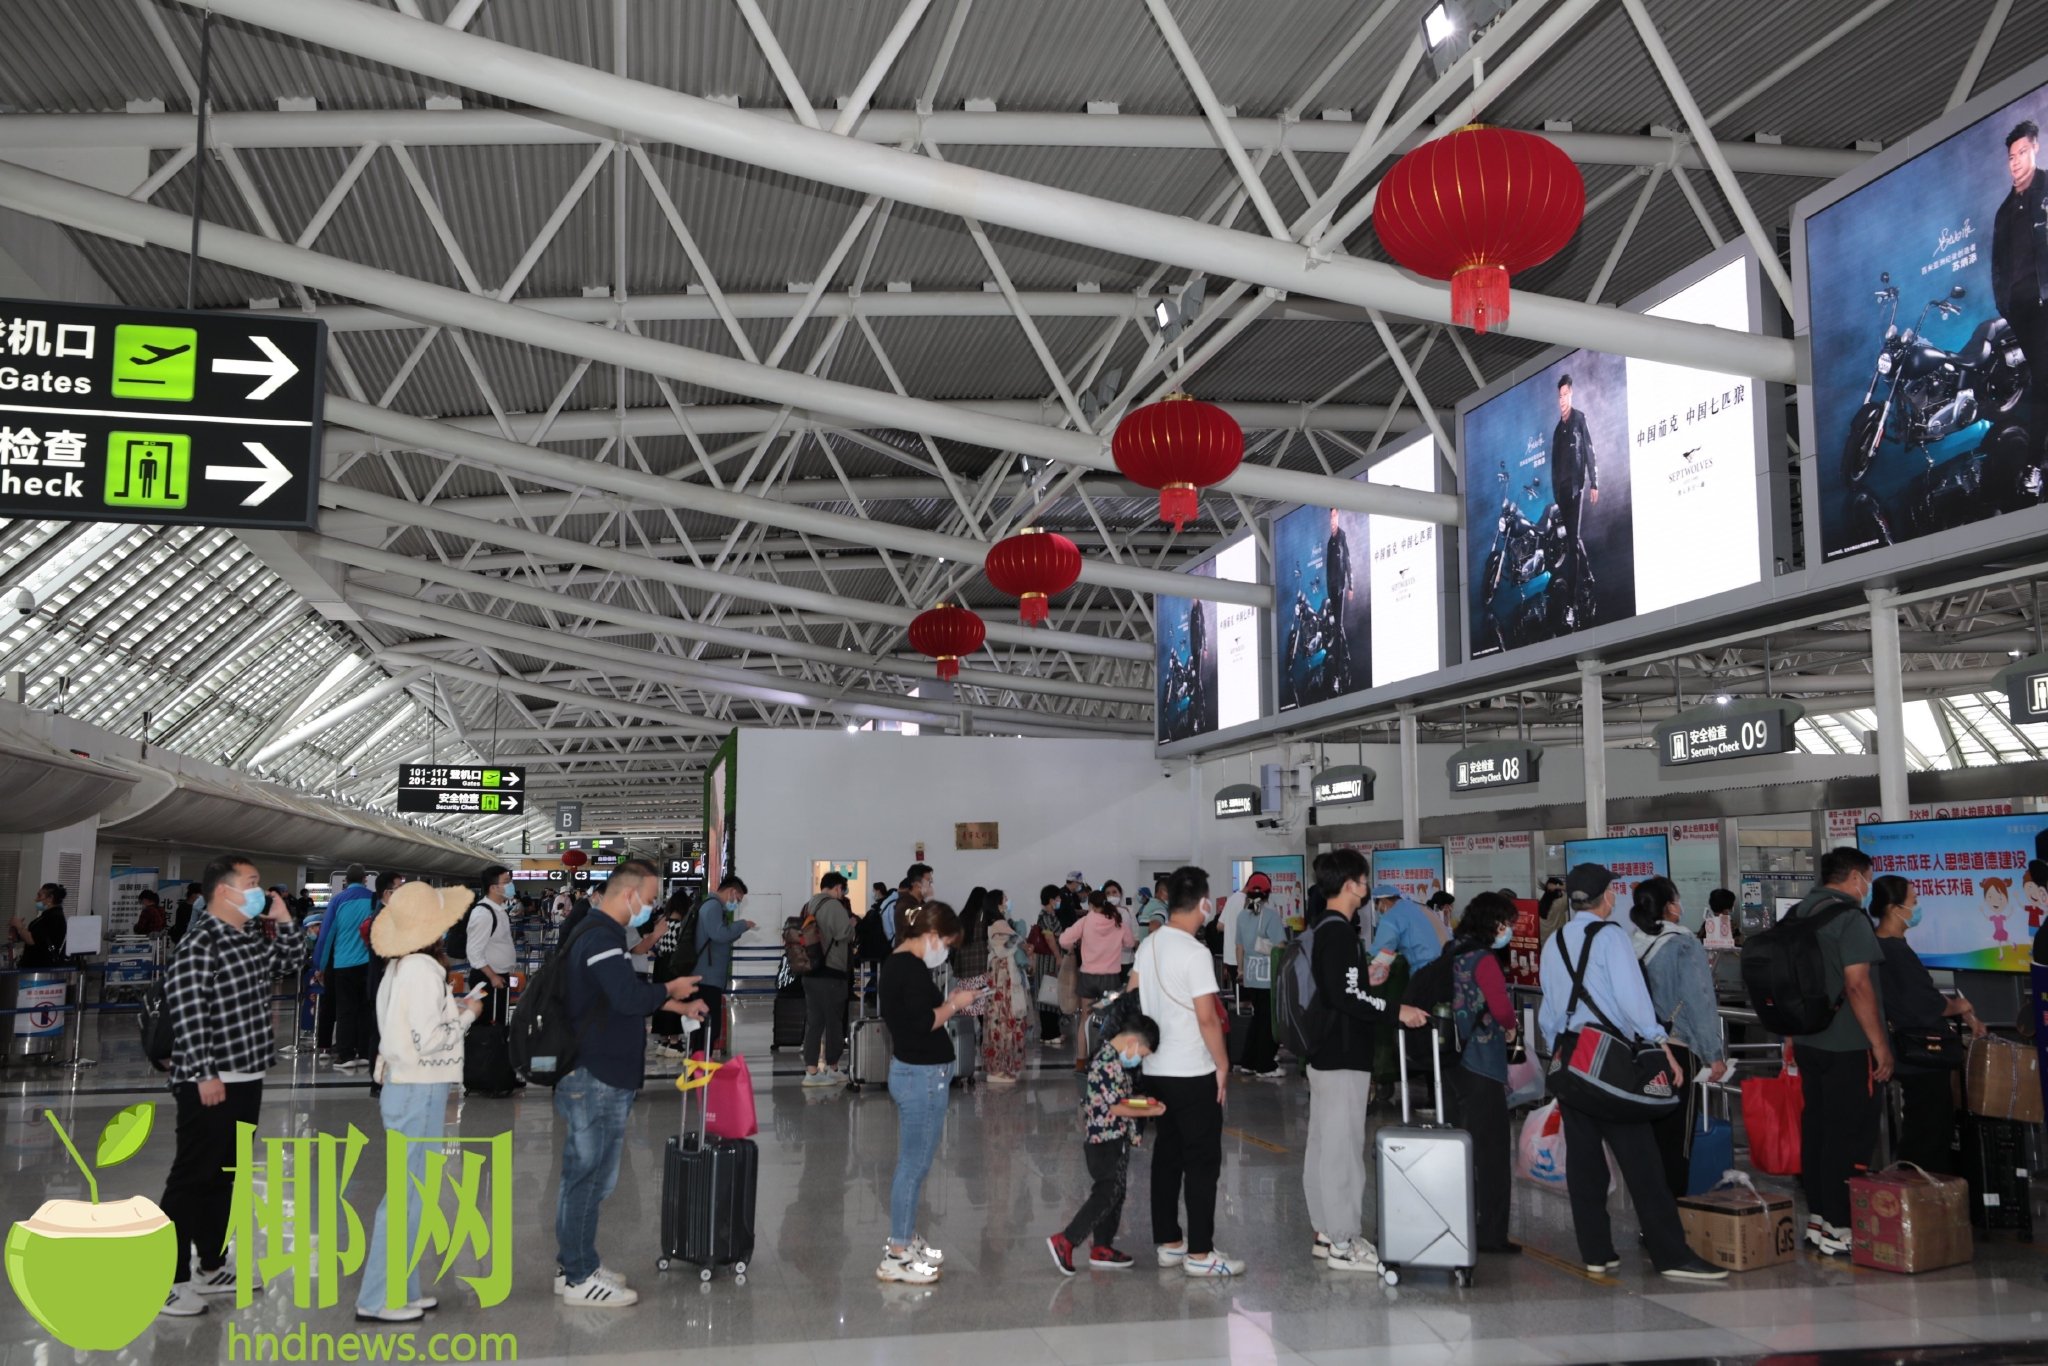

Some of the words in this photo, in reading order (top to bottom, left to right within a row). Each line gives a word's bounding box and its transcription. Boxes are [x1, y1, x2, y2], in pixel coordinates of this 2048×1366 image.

[1952, 252, 1977, 272] 苏炳添
[0, 366, 92, 395] Gates
[1686, 384, 1745, 425] 中国七匹狼
[0, 425, 87, 468] 检查
[1669, 458, 1714, 483] SEPTWOLVES
[1, 468, 84, 498] heck
[1690, 725, 1727, 745] 安全检查
[1741, 720, 1768, 750] 09
[1690, 745, 1718, 759] Security
[1718, 741, 1740, 754] Check
[409, 768, 448, 777] 101-117
[449, 769, 482, 780] 登机口
[1470, 759, 1495, 774] 安全检查
[1502, 757, 1519, 781] 08
[408, 777, 448, 786] 201-218
[1470, 775, 1488, 784] Security
[1488, 772, 1502, 782] Check
[1352, 780, 1362, 797] 07
[438, 793, 480, 804] 安全检查
[563, 813, 573, 827] B
[672, 861, 690, 873] B9
[1871, 850, 2027, 873] 加强未成年人思想道德建设
[549, 871, 562, 880] C2
[574, 871, 588, 880] C3
[1643, 1084, 1672, 1096] adidas
